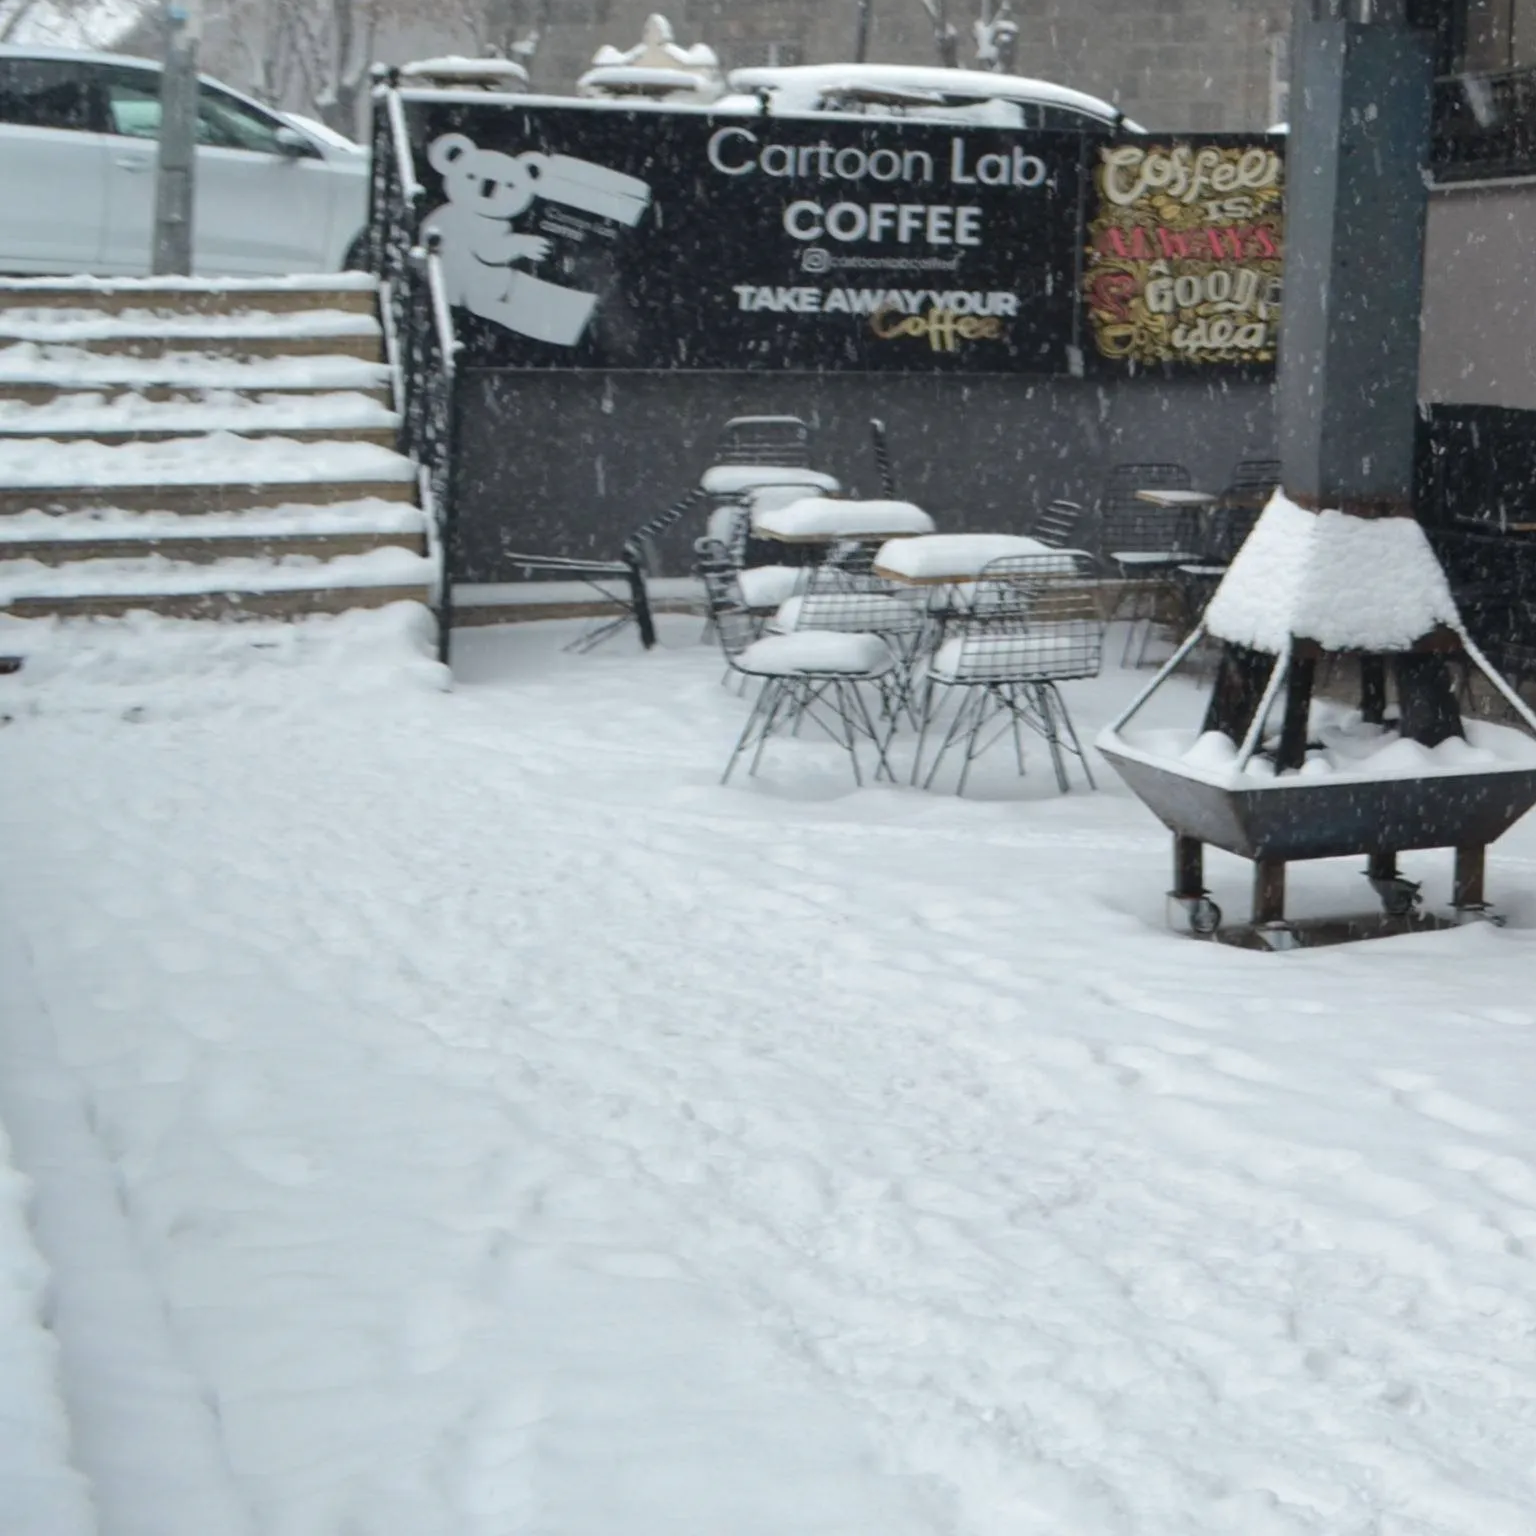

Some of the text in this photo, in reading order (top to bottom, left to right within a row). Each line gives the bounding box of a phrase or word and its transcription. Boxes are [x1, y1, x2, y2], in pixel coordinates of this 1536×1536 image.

[707, 126, 934, 183] Cartoon
[1101, 146, 1284, 207] Coffee
[782, 200, 983, 246] COFFEE
[1098, 224, 1280, 260] ALWAYS
[732, 285, 1019, 317] TAKE AWAY YOUR
[1144, 266, 1260, 314] GOOD
[870, 302, 1003, 352] Coffee
[1170, 317, 1268, 351] idea
